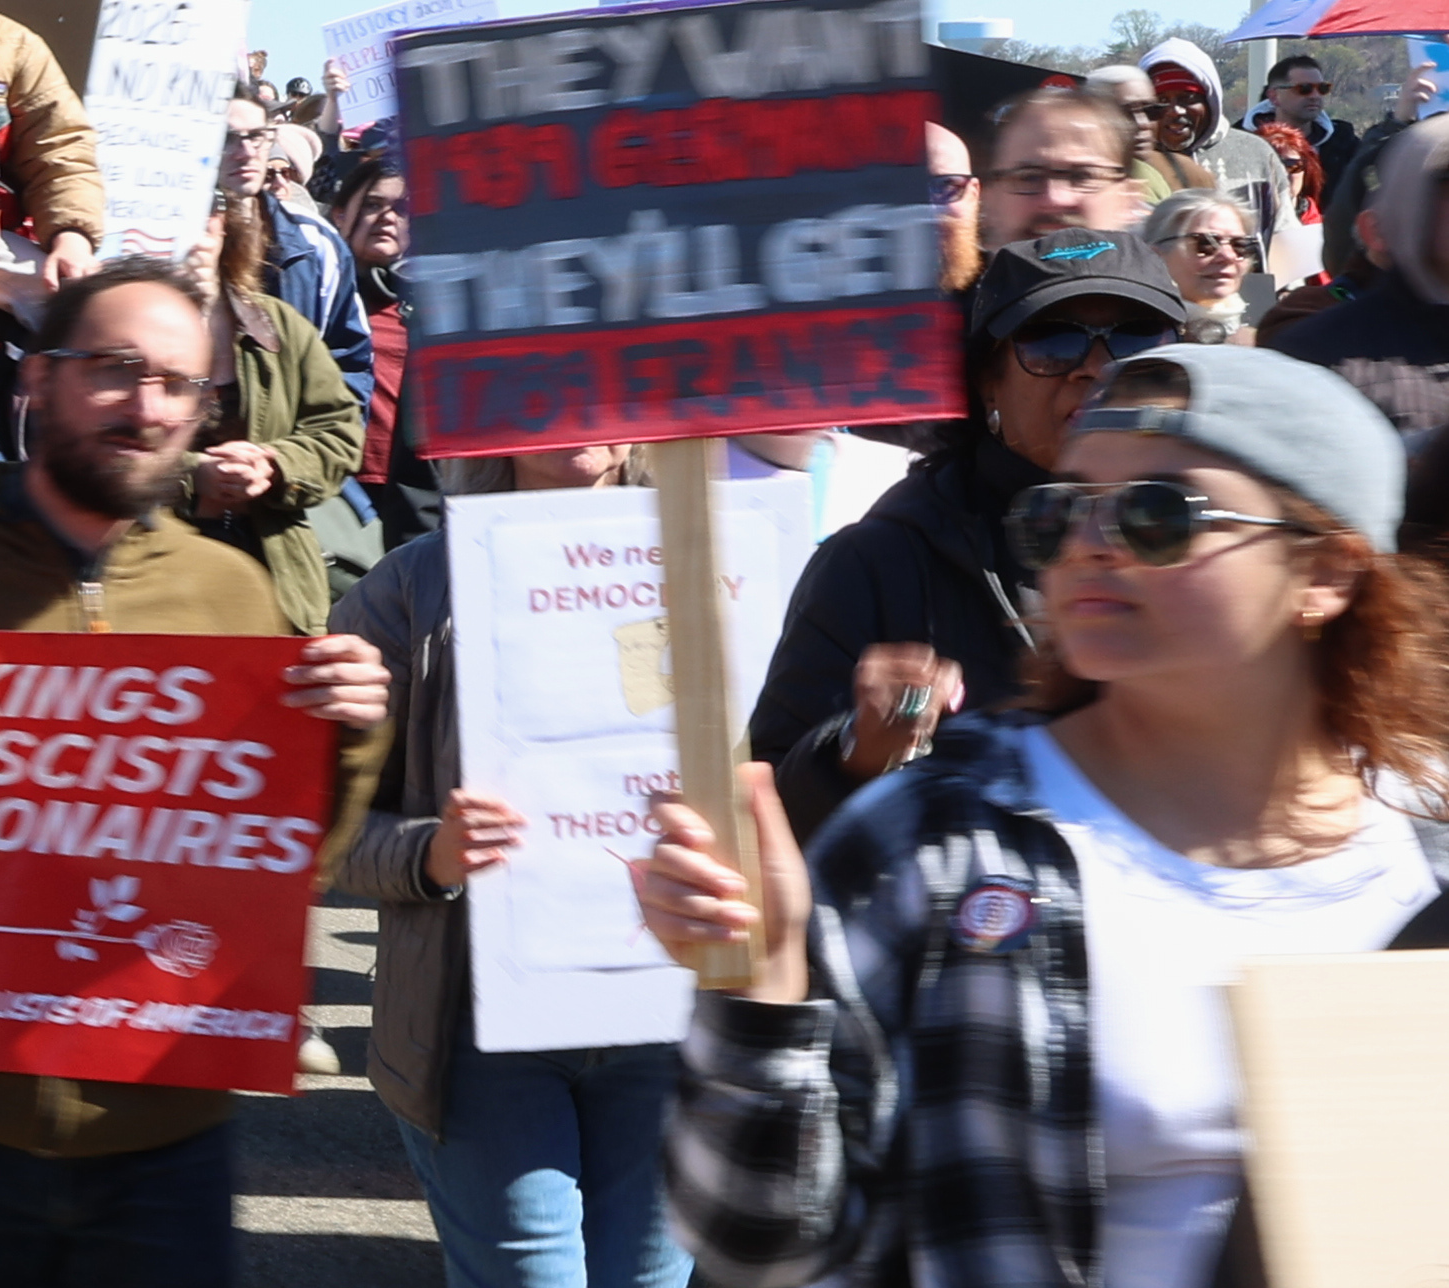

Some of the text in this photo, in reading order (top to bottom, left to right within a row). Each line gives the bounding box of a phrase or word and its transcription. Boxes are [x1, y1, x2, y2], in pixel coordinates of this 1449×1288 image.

[397, 19, 667, 128] THEY
[759, 203, 950, 304] GET
[561, 542, 615, 570] We
[623, 769, 681, 797] not
[75, 996, 139, 1029] OF
[127, 999, 298, 1042] AMERICA
